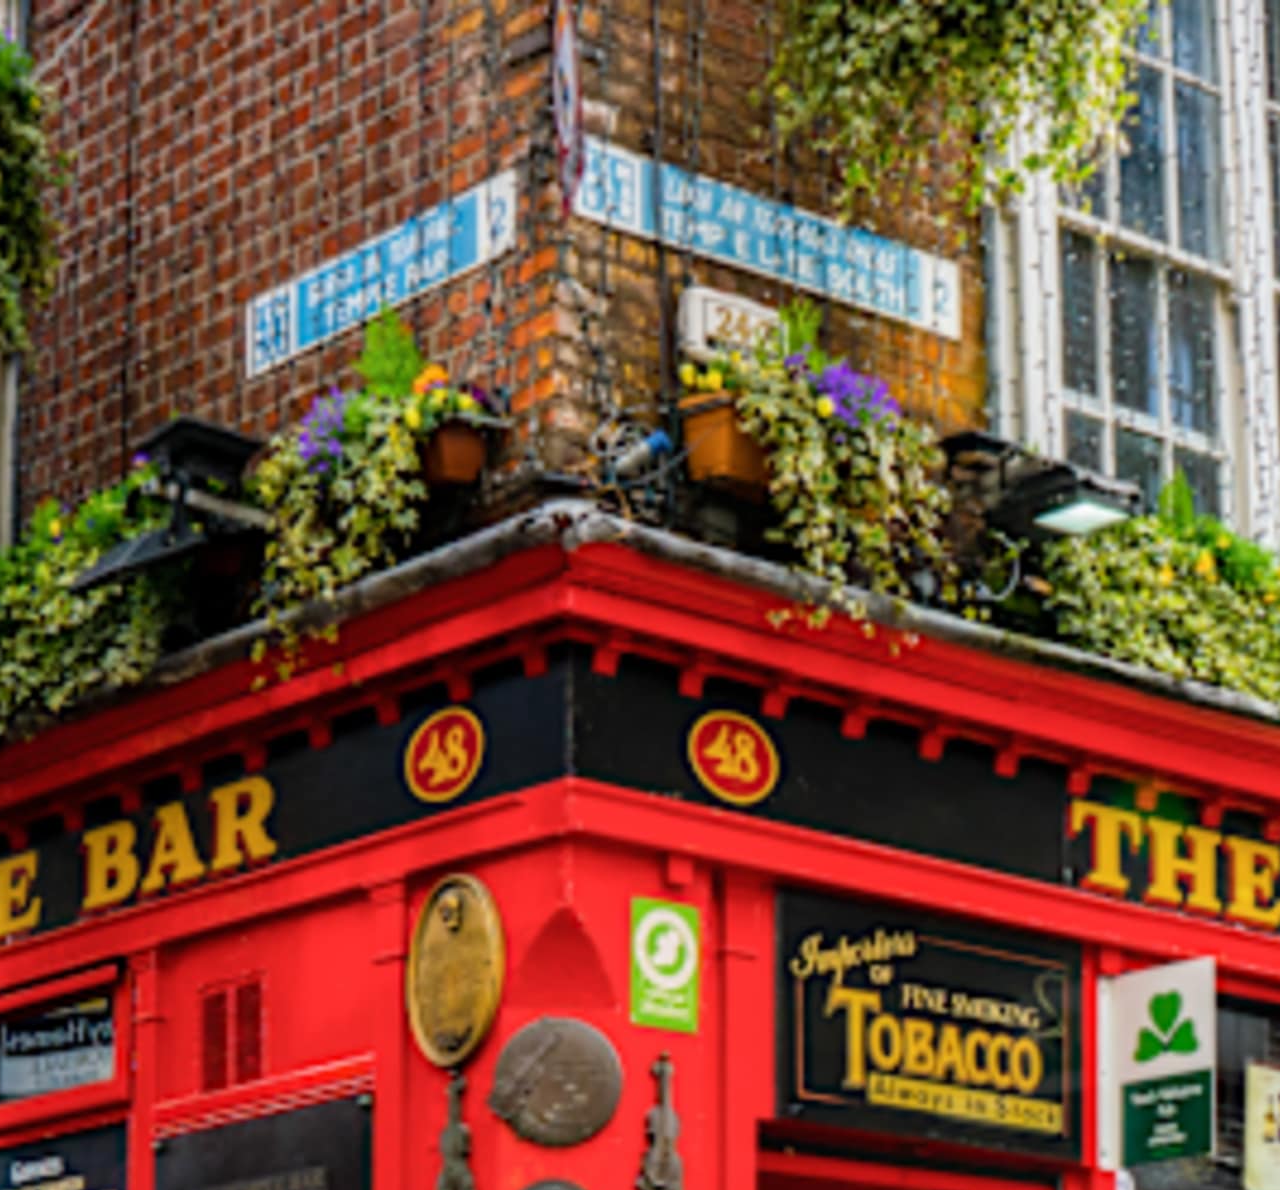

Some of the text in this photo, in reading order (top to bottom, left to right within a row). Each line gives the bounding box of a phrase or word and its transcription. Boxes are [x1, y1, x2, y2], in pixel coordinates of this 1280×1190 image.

[418, 724, 468, 787] 48
[705, 726, 758, 784] 48
[80, 776, 278, 912] BAR
[824, 985, 1045, 1094] TOBACCO
